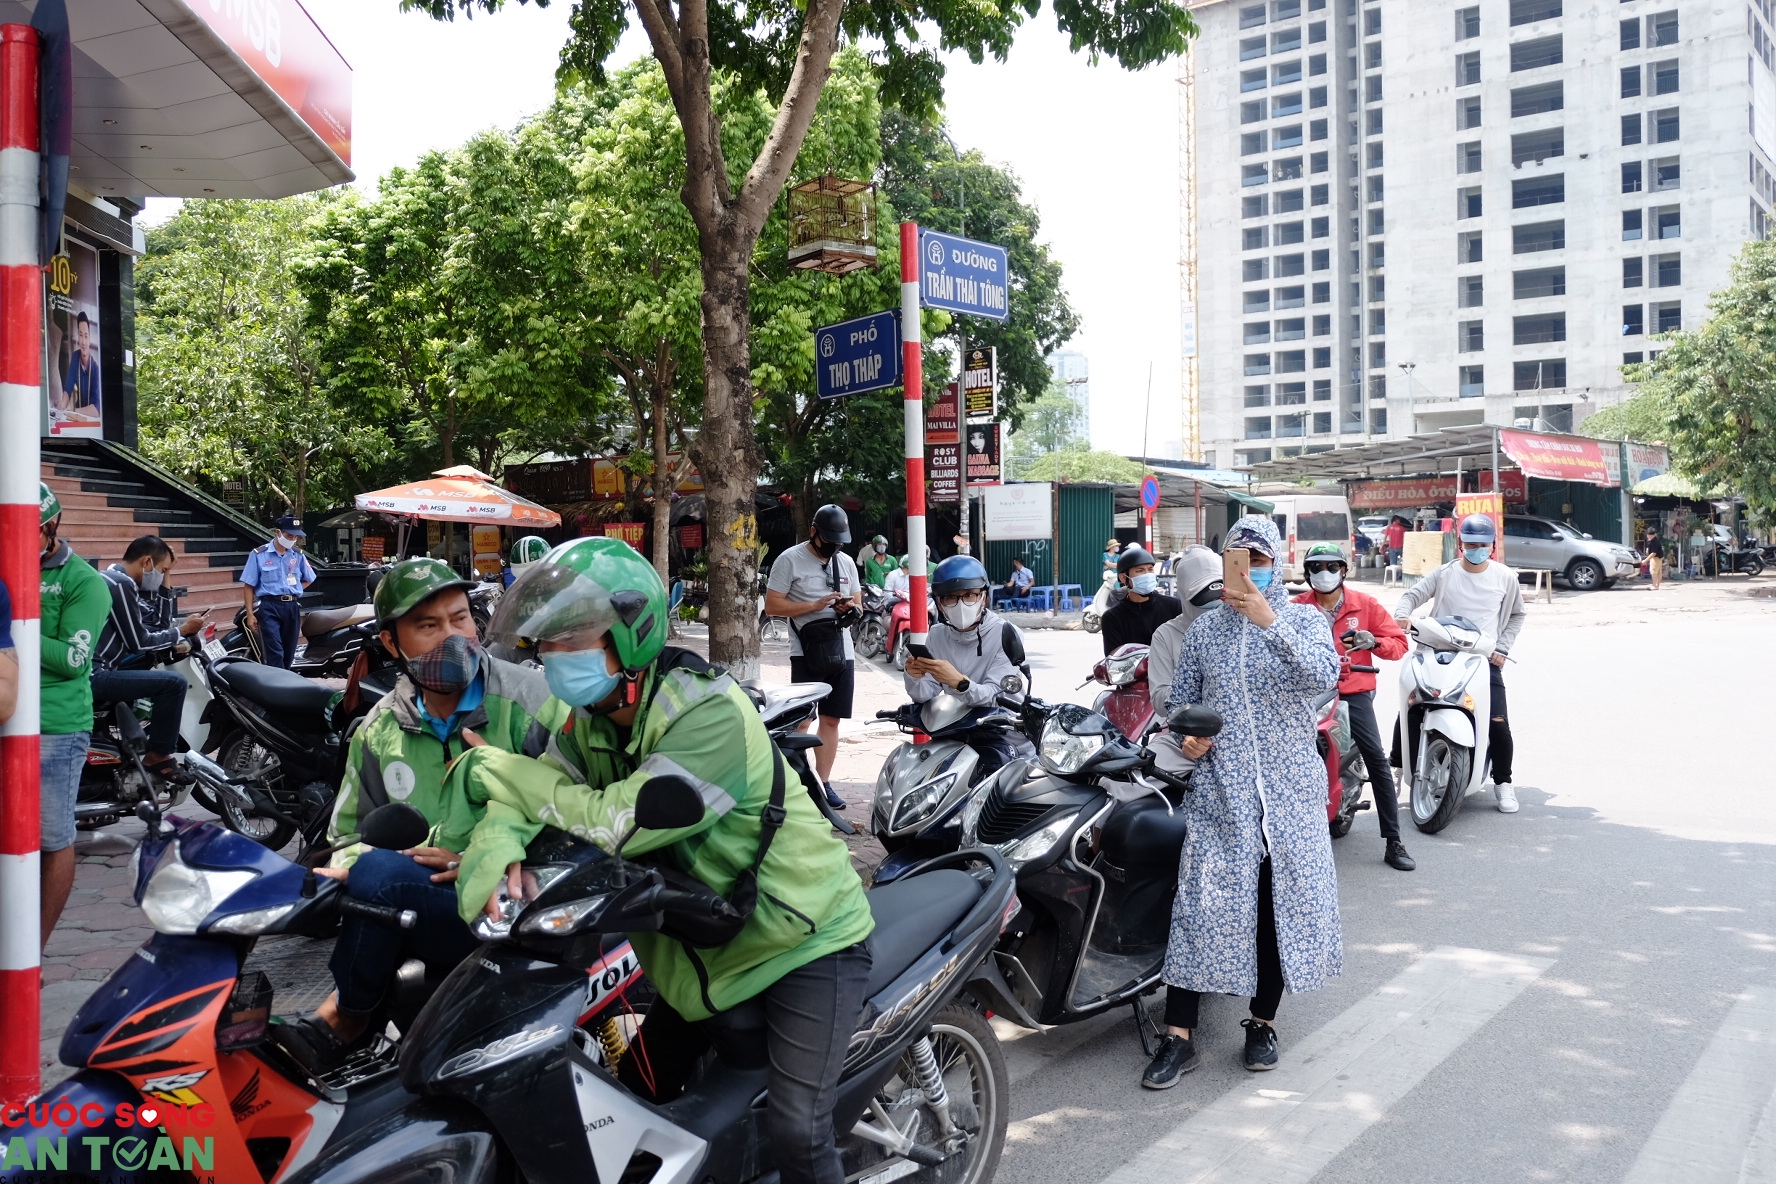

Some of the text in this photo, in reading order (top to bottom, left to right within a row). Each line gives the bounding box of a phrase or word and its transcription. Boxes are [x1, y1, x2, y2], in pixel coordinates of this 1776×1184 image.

[952, 249, 997, 272] ĐƯỜNG
[927, 267, 1004, 310] TRẦN THÁI TÔNG
[850, 320, 878, 346] PHỐ
[829, 350, 882, 391] THỌ THÁP
[965, 368, 993, 389] HOTEL
[927, 421, 957, 430] MAI VILLA
[934, 448, 956, 456] ROSY
[932, 456, 958, 465] CLUB
[930, 469, 959, 478] BILLIARDS
[967, 465, 1000, 477] MASSAGE
[933, 480, 956, 488] COFFEE
[1363, 484, 1457, 500] ĐIỀU HÒA ÔTÔ
[437, 490, 477, 498] MSB
[1457, 496, 1493, 515] RỬA
[624, 525, 644, 544] TIỆP
[479, 957, 502, 974] NDA
